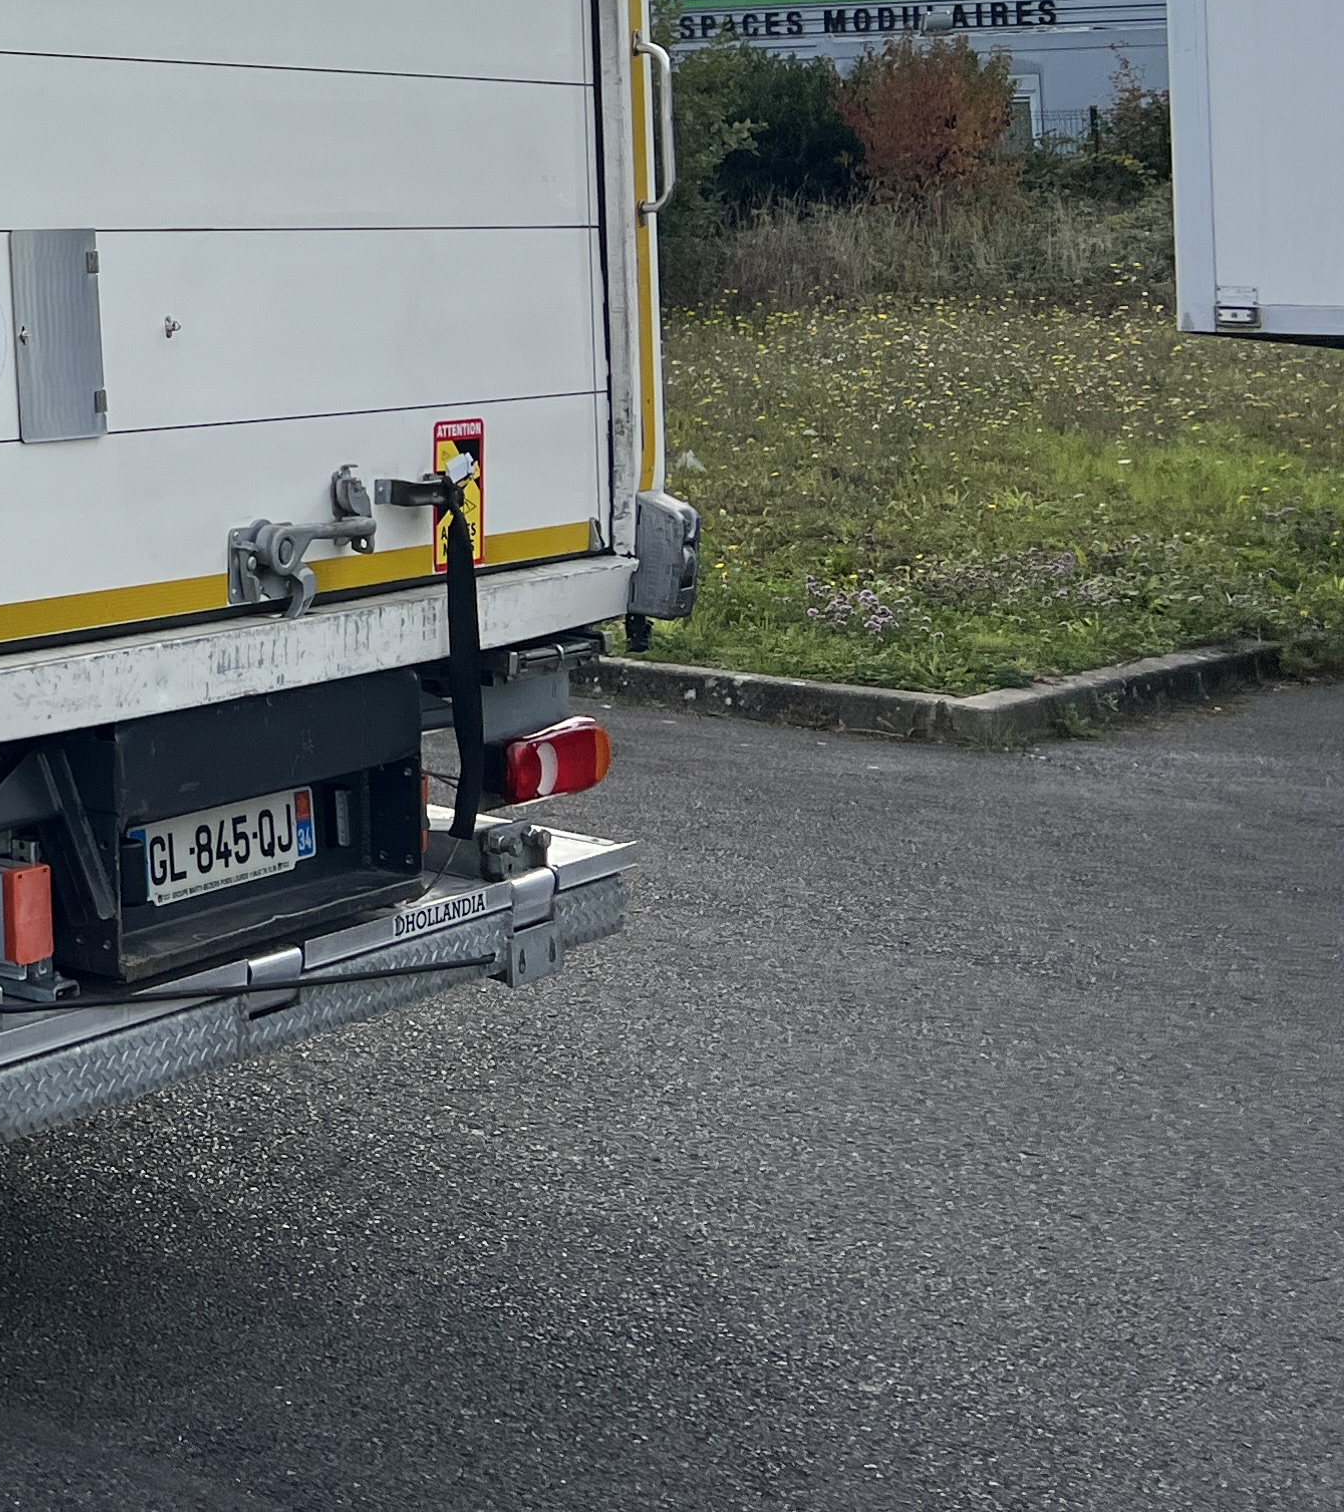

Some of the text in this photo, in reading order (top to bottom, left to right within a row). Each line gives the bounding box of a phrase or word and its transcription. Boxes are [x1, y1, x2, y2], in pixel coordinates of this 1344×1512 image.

[678, 0, 1058, 40] SPACES MODUAIRES
[436, 422, 482, 438] ATTENTION
[149, 804, 294, 886] GL-845-QJ
[297, 827, 312, 851] 34
[394, 892, 487, 938] DHOLLANDIA
